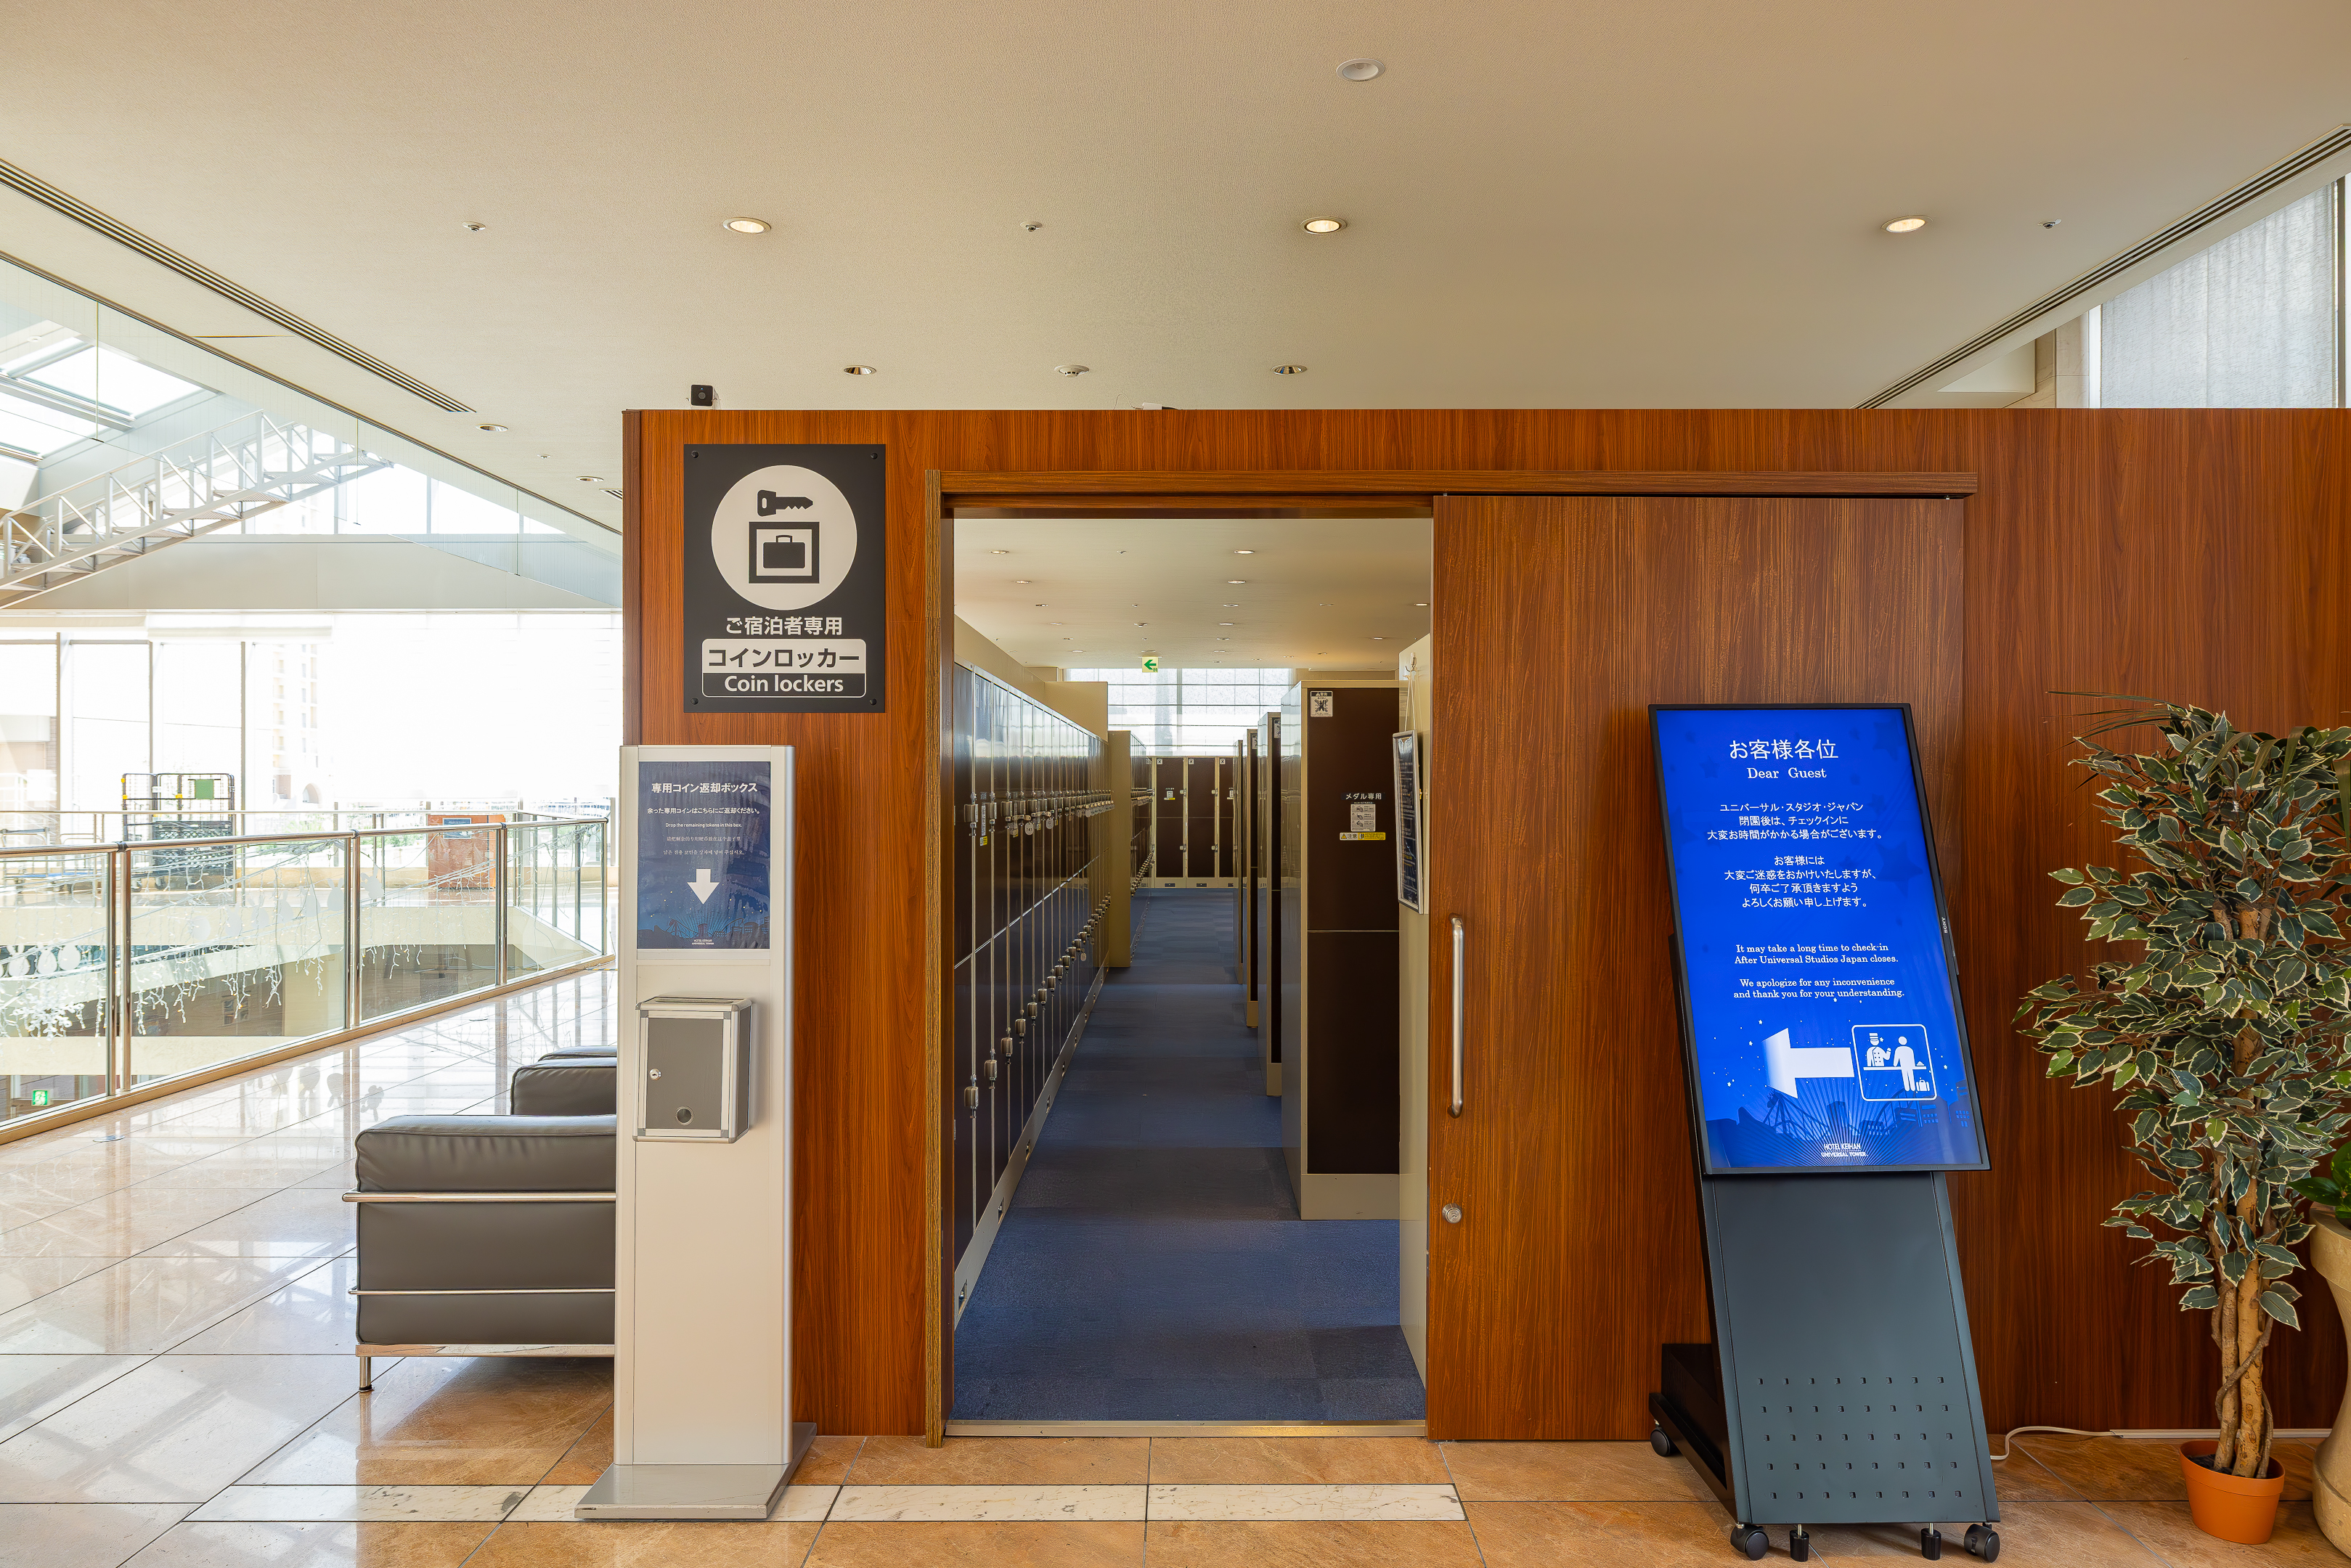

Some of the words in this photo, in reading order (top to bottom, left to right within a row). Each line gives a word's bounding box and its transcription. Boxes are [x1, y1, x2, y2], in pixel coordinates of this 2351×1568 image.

[727, 616, 842, 634] ご宿泊者専用
[709, 648, 859, 668] コインロッカー
[725, 675, 767, 691] Coin
[775, 675, 843, 692] lockers
[1729, 739, 1838, 759] お客様各位
[1747, 768, 1779, 778] Dear
[1788, 767, 1827, 777] Guest
[651, 783, 757, 793] 専用コイン返却ボックス
[1720, 802, 1863, 812] ユニバーサル・スタジオ・ジャパン
[1739, 816, 1849, 826] 閉園後は、チェックインに
[1707, 829, 1881, 840] 大変お時間がかかる場合がございます。
[1775, 855, 1825, 865] お客様には
[1724, 869, 1875, 880] 大変ご迷惑をおかけいたしますが、
[1750, 883, 1857, 894] 何卒ご了承頂きますよう
[1743, 897, 1866, 907] よろしくお願い申し上げます。
[1797, 944, 1816, 953] long
[1841, 955, 1868, 964] Japan
[1756, 979, 1797, 988] apologize
[1814, 991, 1835, 1000] your
[1837, 989, 1904, 999] understanding.
